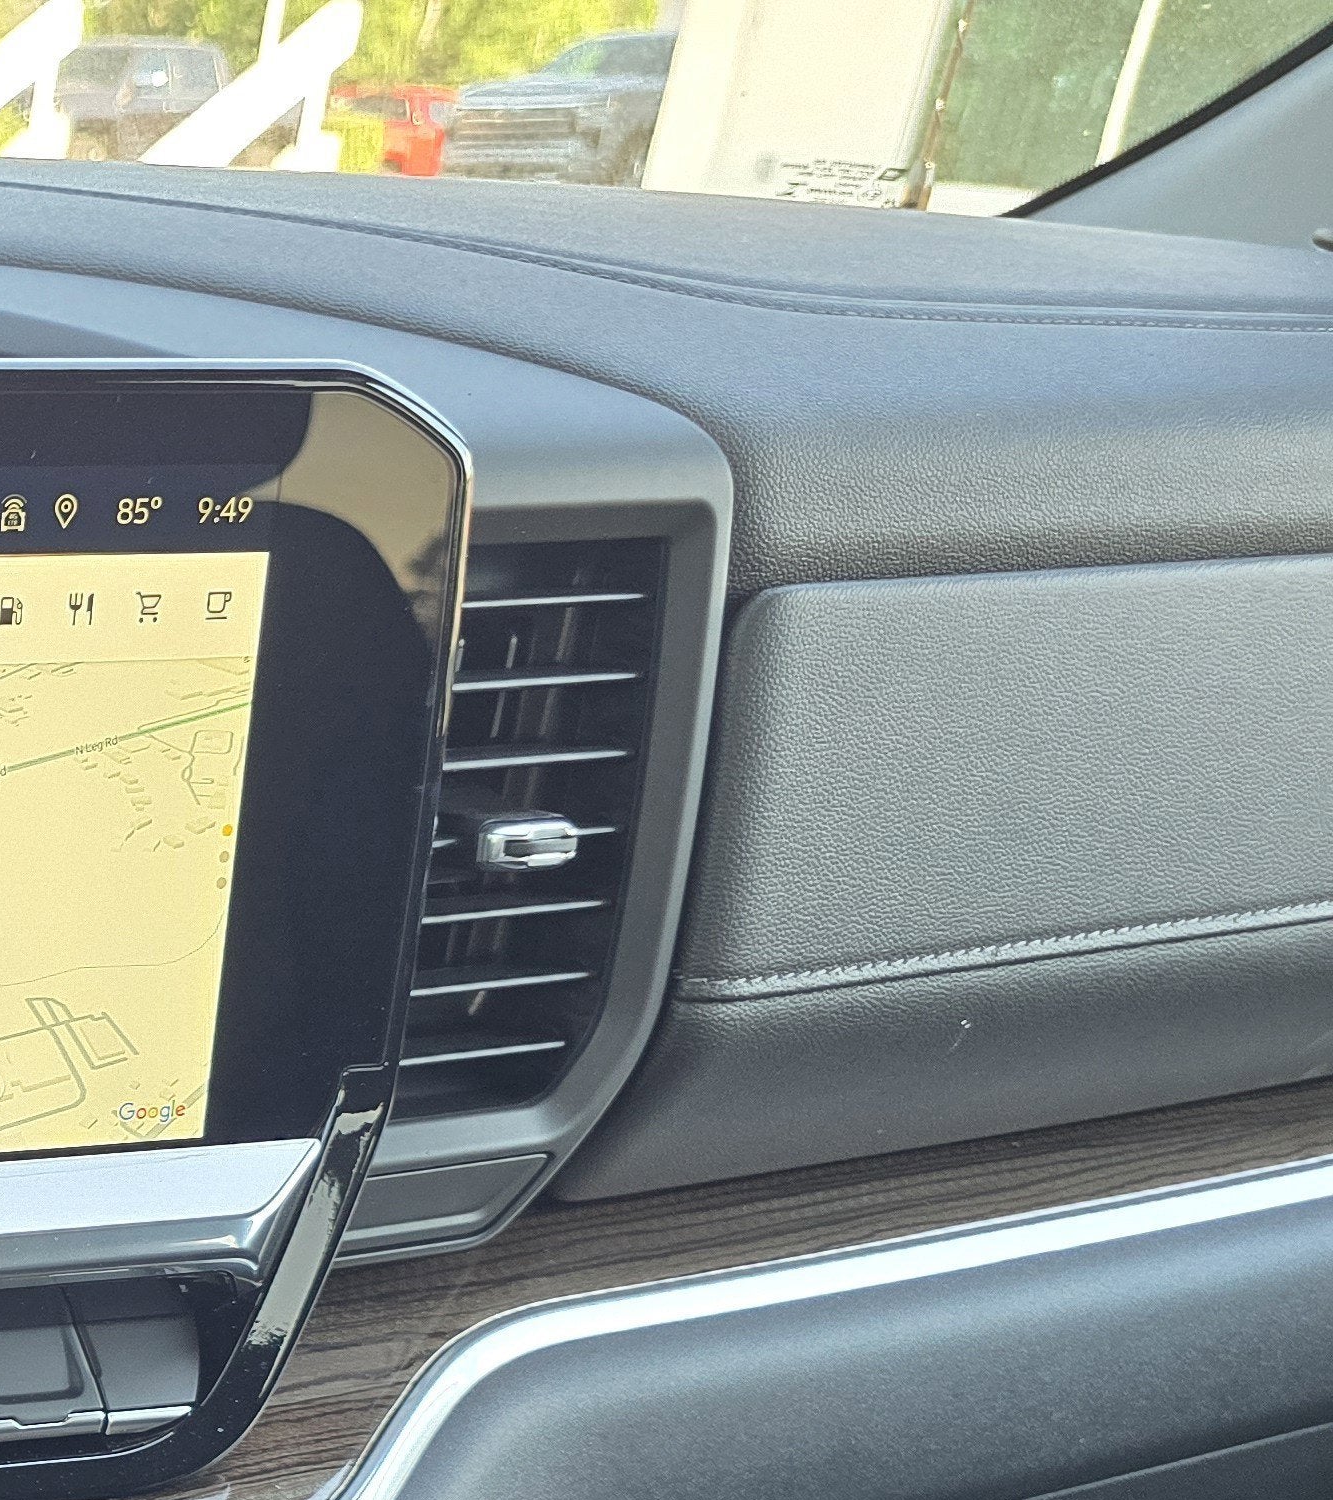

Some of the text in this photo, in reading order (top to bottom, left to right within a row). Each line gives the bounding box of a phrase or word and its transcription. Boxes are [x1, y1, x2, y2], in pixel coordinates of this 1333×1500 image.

[196, 496, 254, 526] 9:49
[75, 735, 119, 755] N Leg Rd
[118, 1100, 186, 1124] Google
